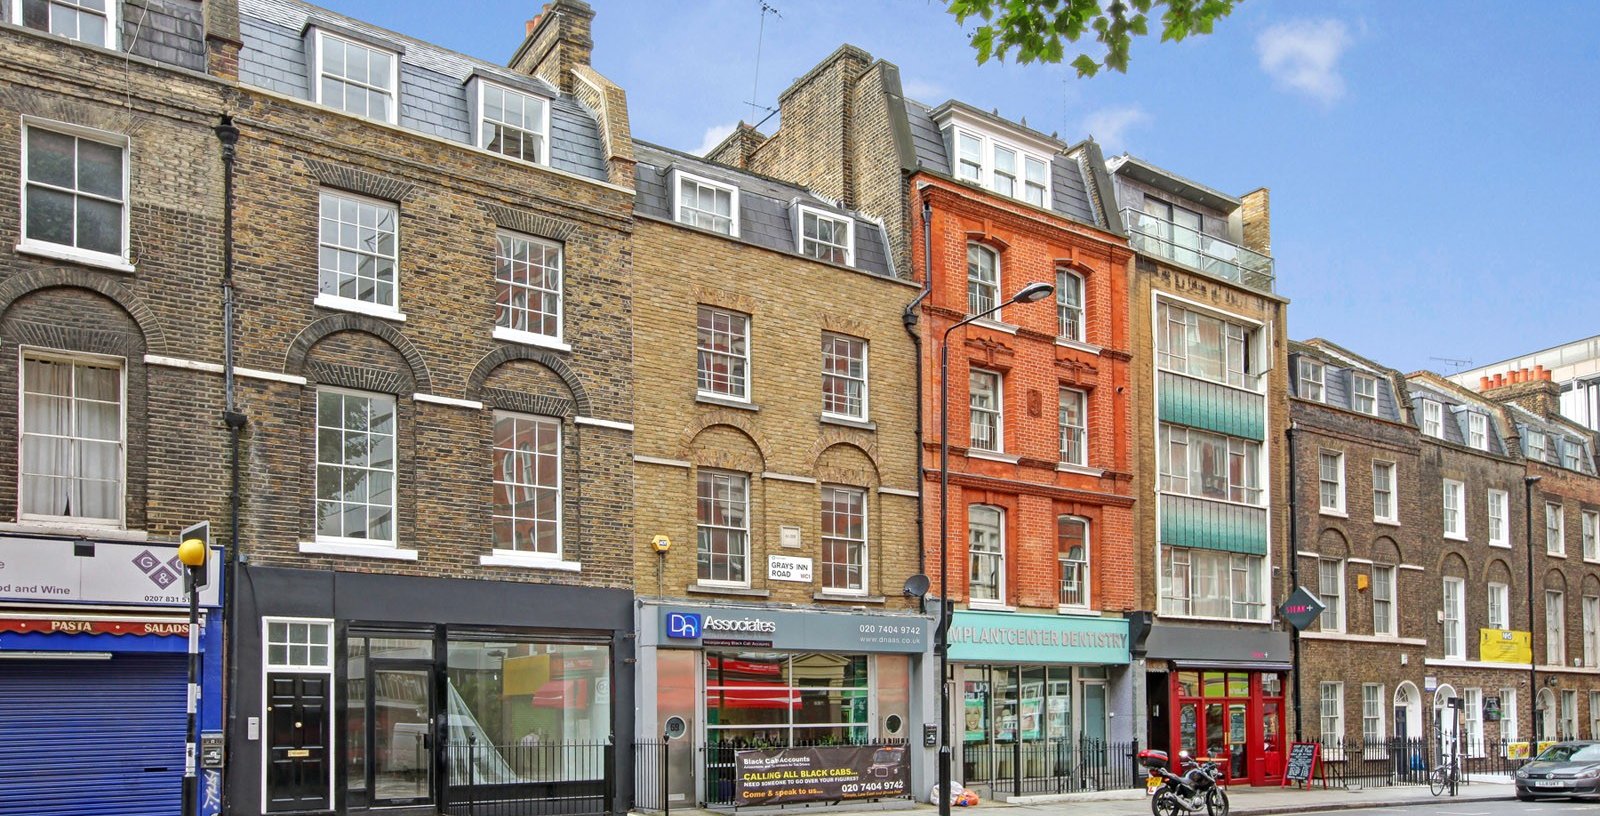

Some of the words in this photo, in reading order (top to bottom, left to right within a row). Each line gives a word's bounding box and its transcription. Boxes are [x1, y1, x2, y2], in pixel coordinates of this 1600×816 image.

[140, 556, 153, 568] G
[158, 572, 169, 584] &
[771, 561, 794, 570] GRAYS
[795, 563, 808, 571] INN
[771, 569, 791, 578] ROAD
[15, 585, 37, 593] and
[41, 585, 71, 595] Wine
[51, 621, 92, 631] PASTA
[144, 623, 189, 633] SALADS
[703, 615, 776, 633] Associates
[859, 624, 875, 633] 020
[878, 625, 898, 634] 7404
[900, 626, 920, 635] 9742
[948, 625, 1059, 647] MPLANTCENTER
[1062, 630, 1127, 649] DENTISTRY
[670, 723, 680, 731] 69
[743, 771, 781, 780] CALLING
[783, 770, 799, 778] ALL
[800, 769, 828, 778] BLACK
[841, 783, 858, 792] 020
[860, 782, 882, 791] 7404
[884, 780, 904, 789] 9742
[742, 790, 766, 798] Come
[767, 789, 773, 797] &
[775, 788, 797, 797] speak
